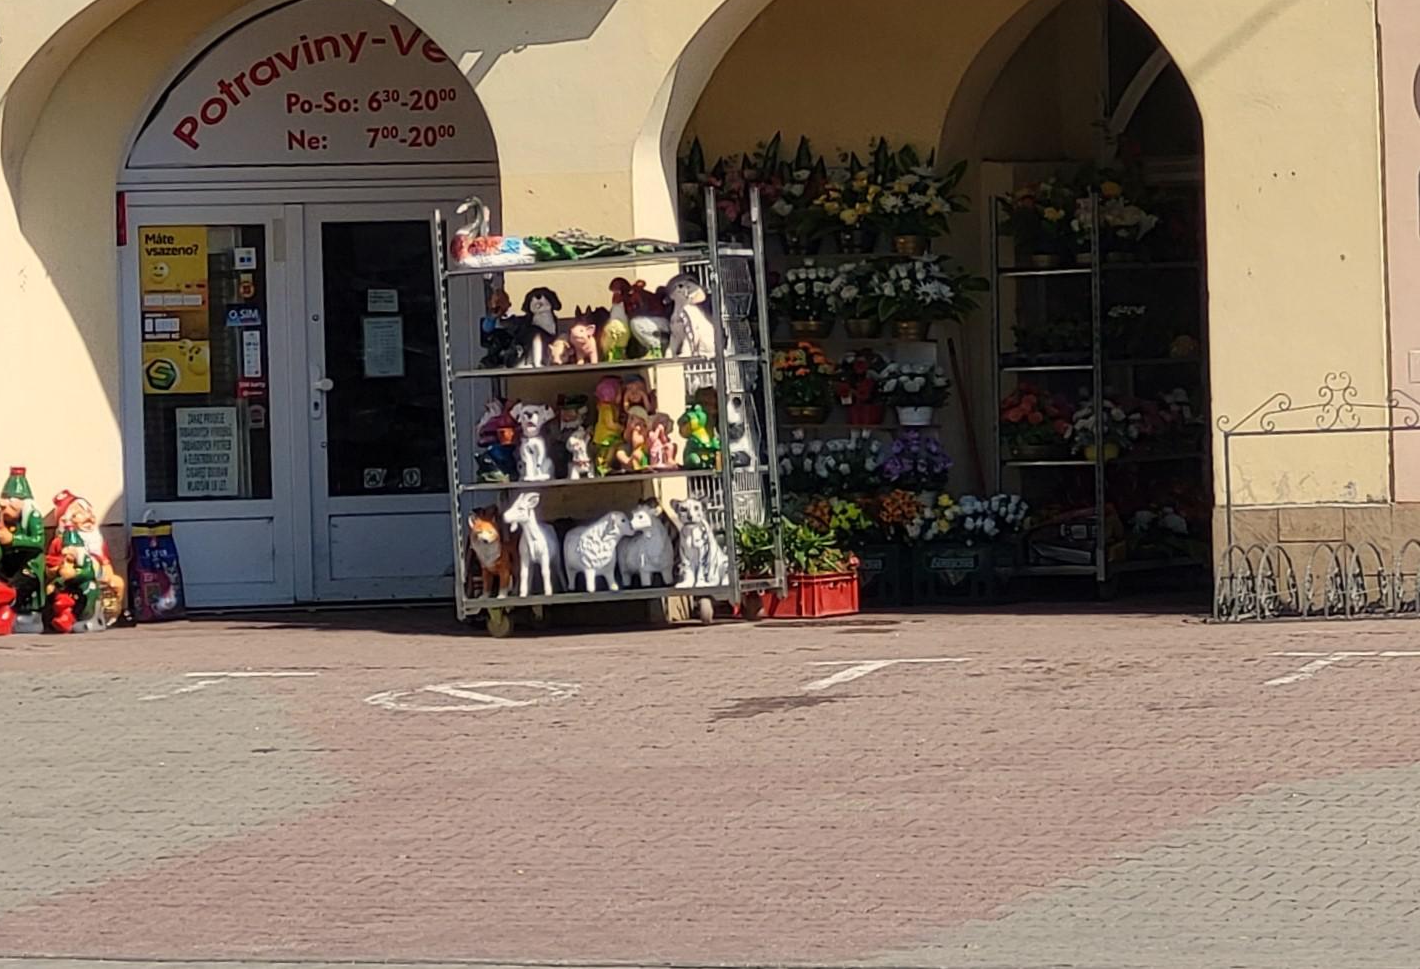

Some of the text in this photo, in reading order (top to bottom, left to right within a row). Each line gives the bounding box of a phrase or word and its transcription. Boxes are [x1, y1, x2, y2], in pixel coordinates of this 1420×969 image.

[286, 92, 359, 113] Po-So:
[287, 130, 328, 150] Ne:
[145, 232, 174, 245] Máte
[145, 243, 199, 256] vsazeno?
